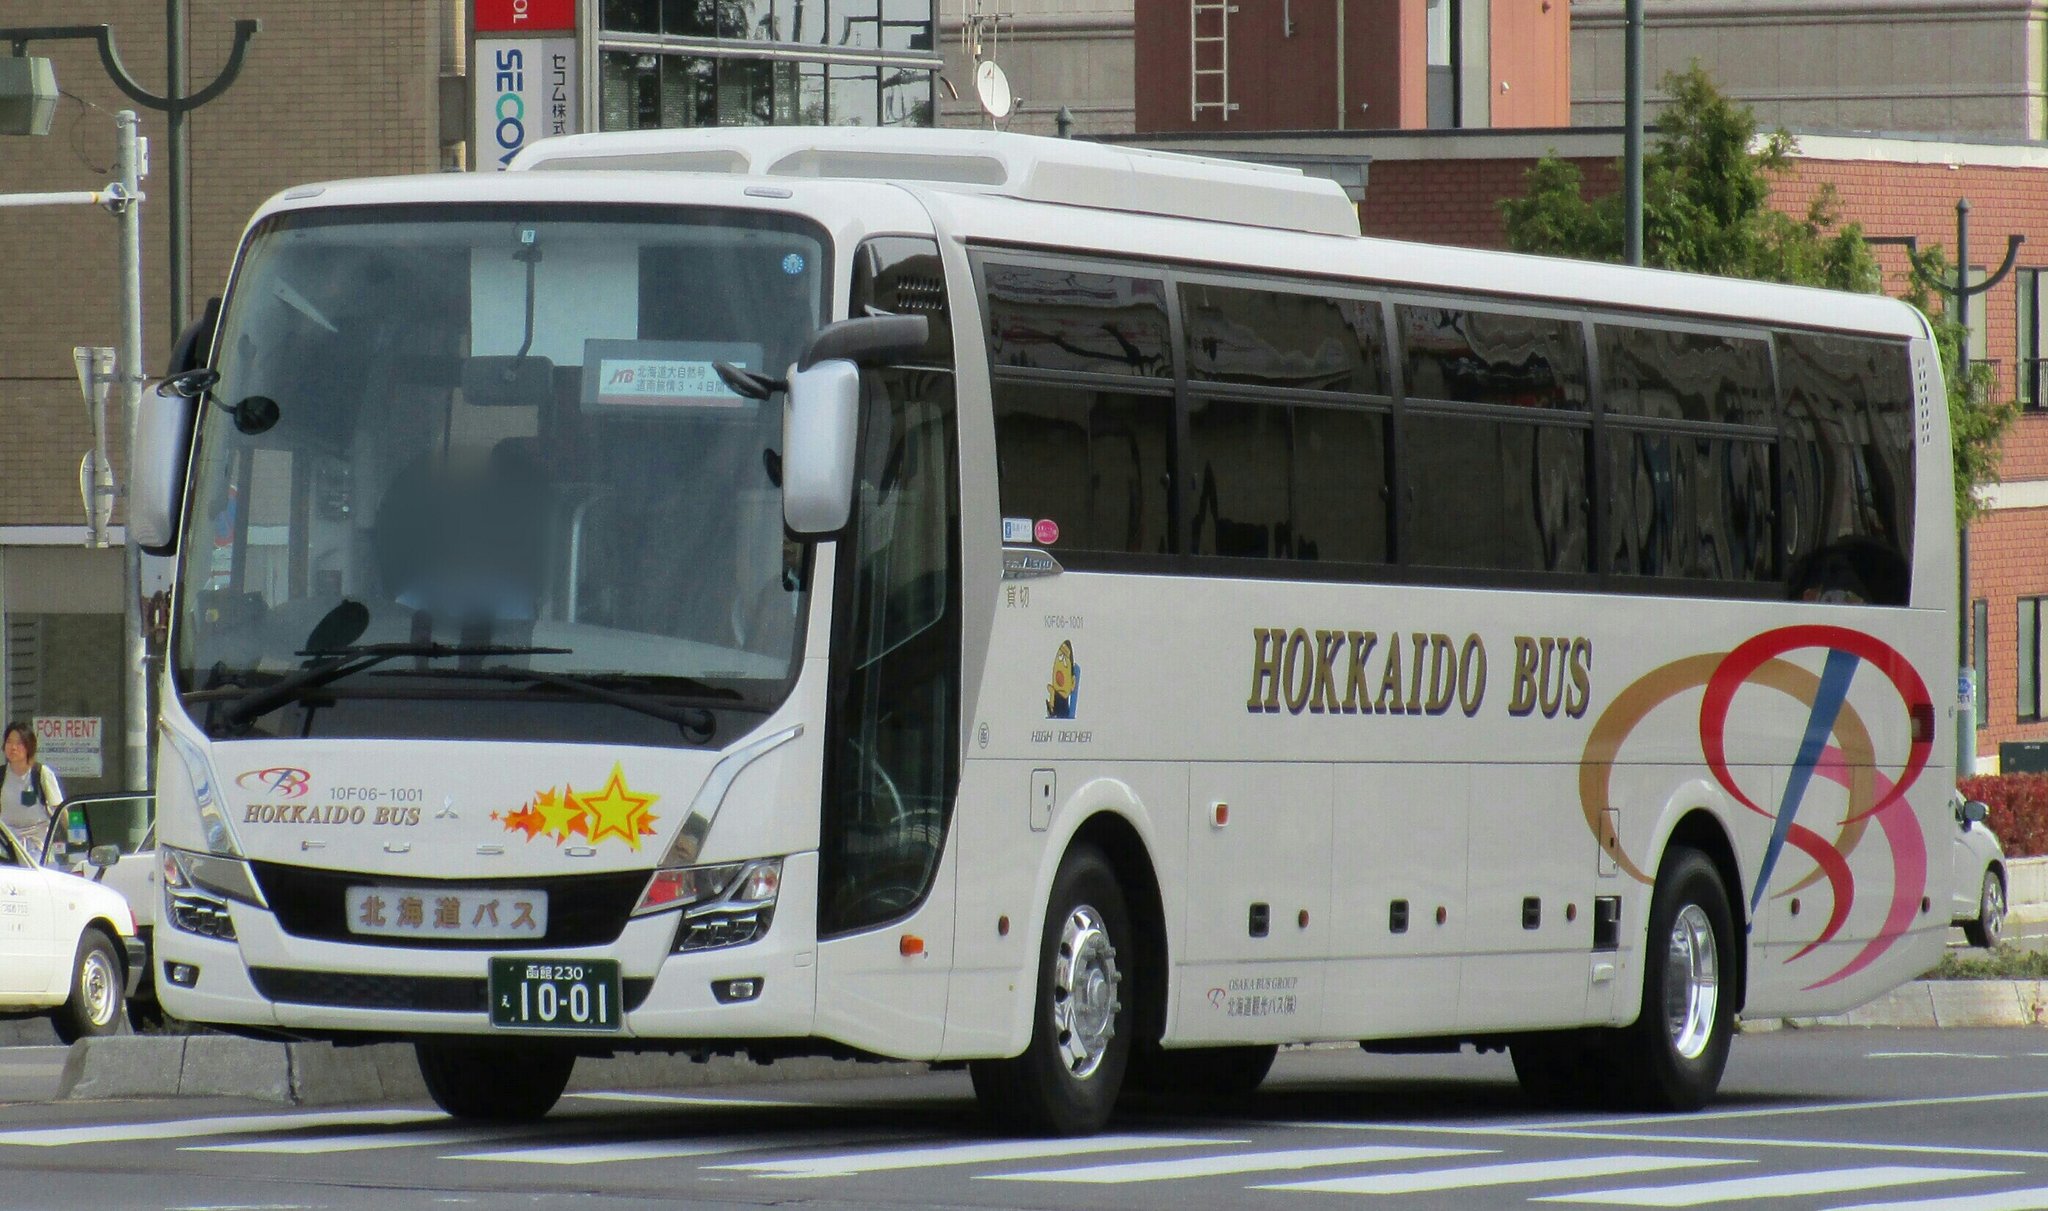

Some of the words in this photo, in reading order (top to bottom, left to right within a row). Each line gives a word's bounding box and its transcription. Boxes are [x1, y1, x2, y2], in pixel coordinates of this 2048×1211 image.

[552, 54, 566, 135] セコム株式
[609, 368, 635, 385] JTB
[637, 366, 706, 380] 北海道大自然号
[1247, 627, 1488, 718] HOKKAIDO
[1508, 636, 1593, 719] BUS
[37, 719, 62, 738] FOR
[65, 719, 97, 738] RENT
[330, 787, 424, 802] 10F06-1001
[243, 804, 366, 825] HOKKAIDO
[373, 806, 421, 827] BUS
[360, 895, 536, 930] 北海道バス
[521, 982, 607, 1023] 10-01
